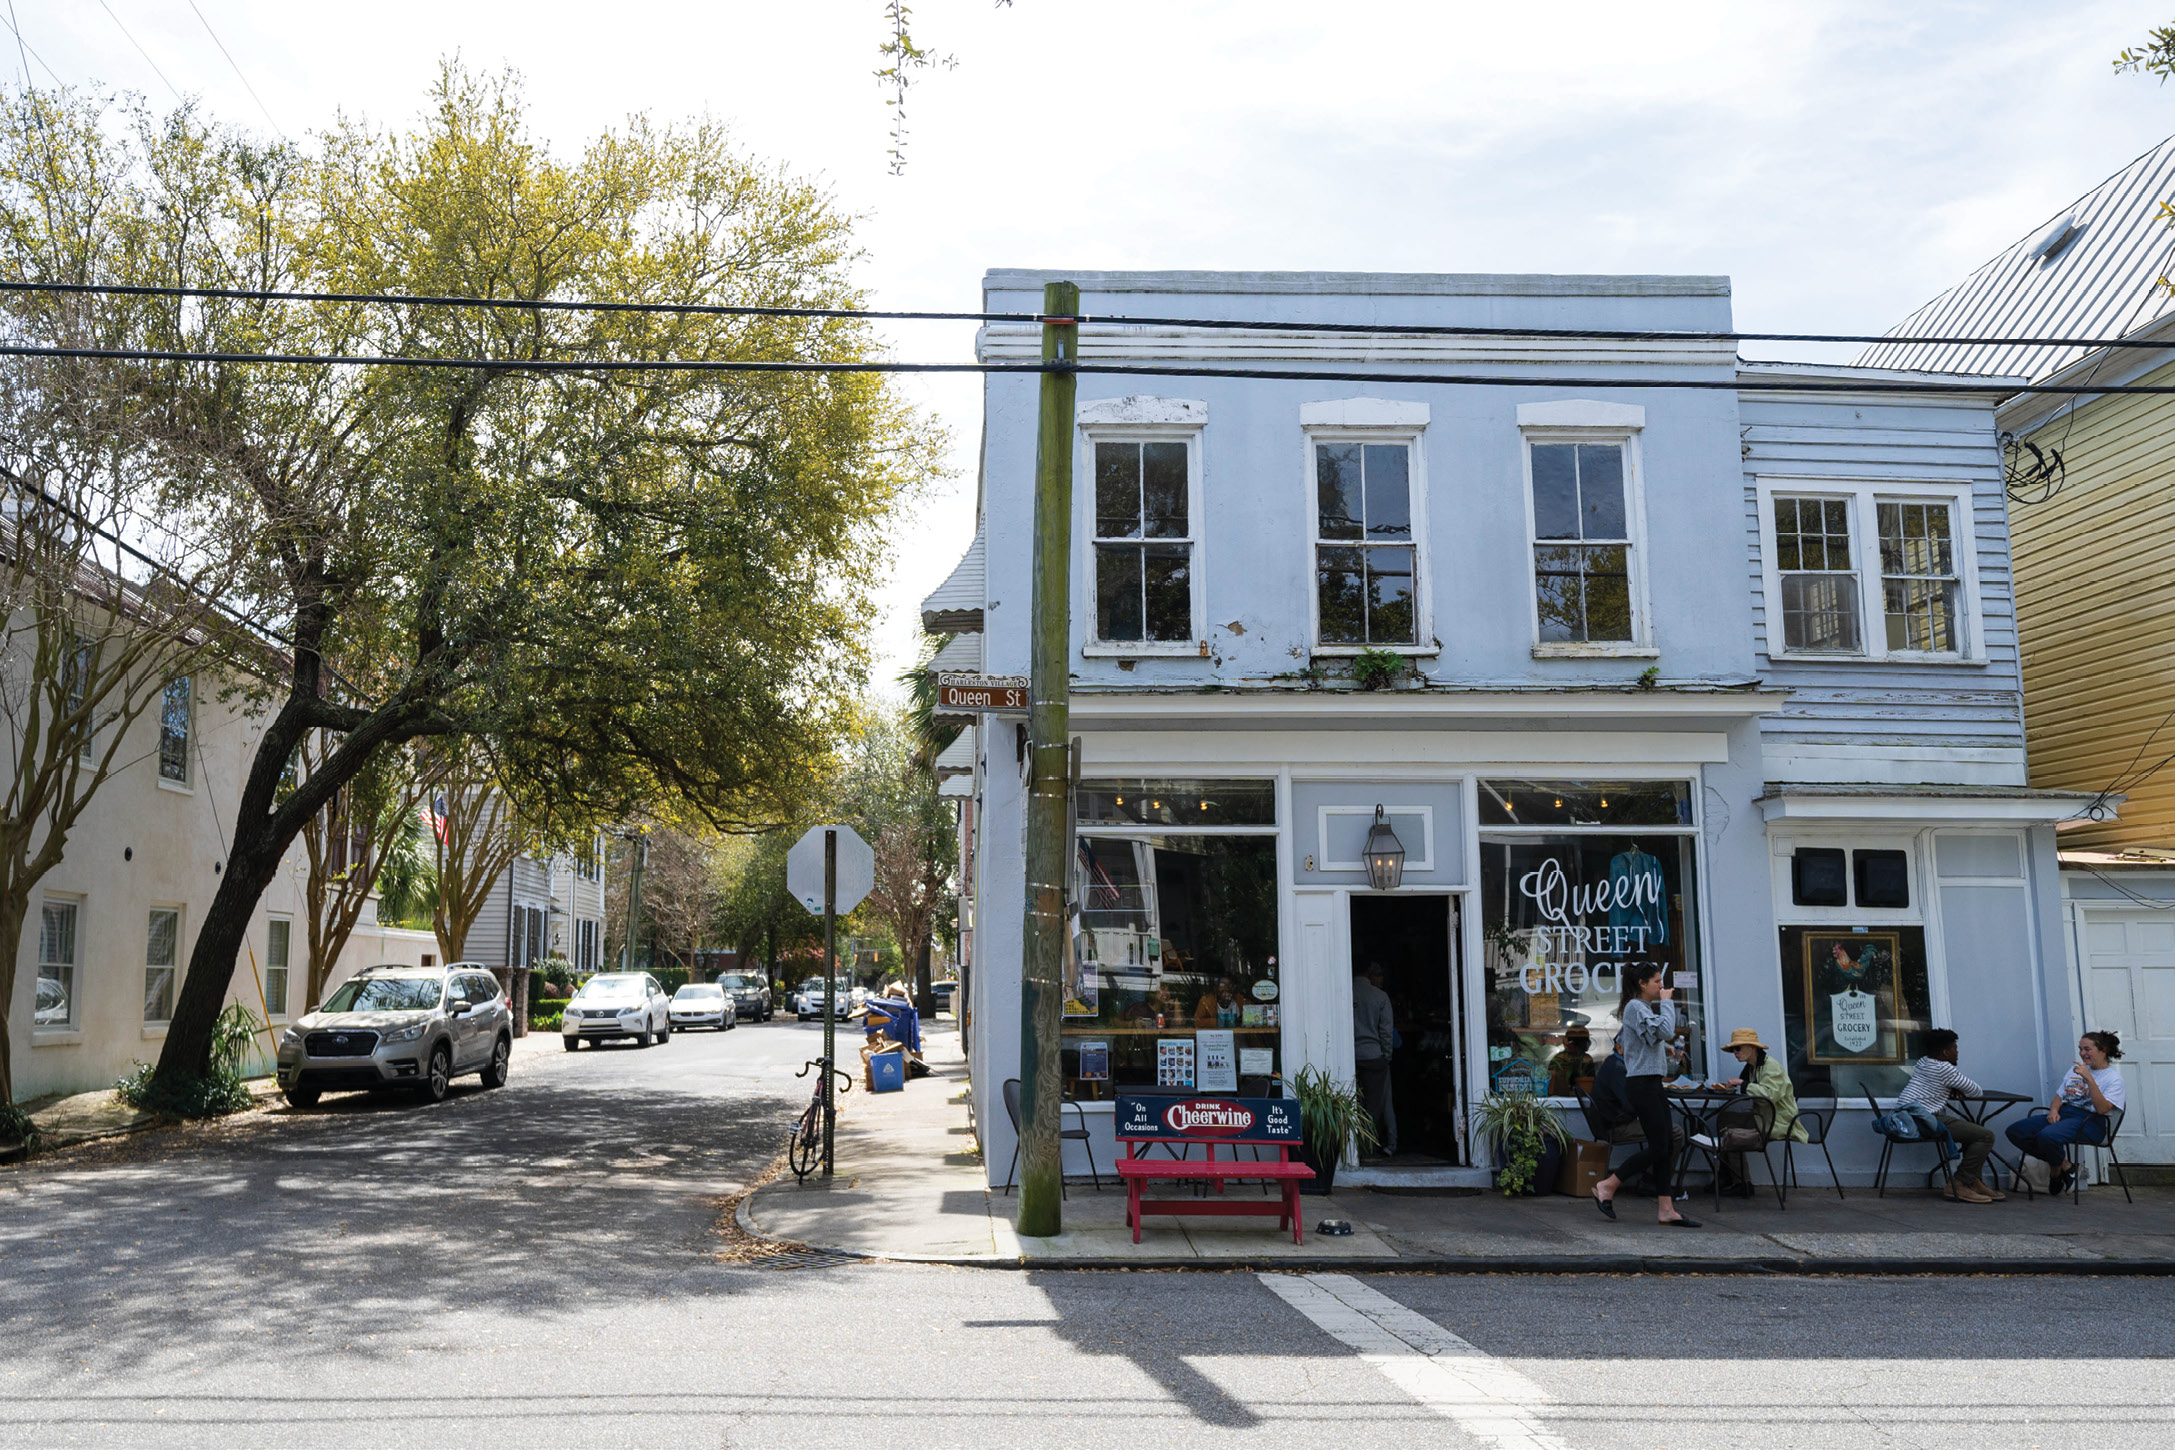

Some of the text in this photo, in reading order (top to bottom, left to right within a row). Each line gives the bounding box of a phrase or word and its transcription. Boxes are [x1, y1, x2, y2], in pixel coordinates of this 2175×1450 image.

[949, 688, 1021, 707] Queen St
[1519, 857, 1662, 938] Queen
[1537, 925, 1652, 954] STREET
[1519, 961, 1670, 995] GROC
[1836, 997, 1866, 1012] Queen
[1840, 1012, 1865, 1020] STREET
[1837, 1023, 1871, 1033] GROCERY
[1271, 1105, 1284, 1115] It's
[1134, 1114, 1147, 1122] All
[1167, 1105, 1251, 1130] Cheerwine
[1267, 1114, 1288, 1125] Good
[1124, 1122, 1159, 1132] Occasions
